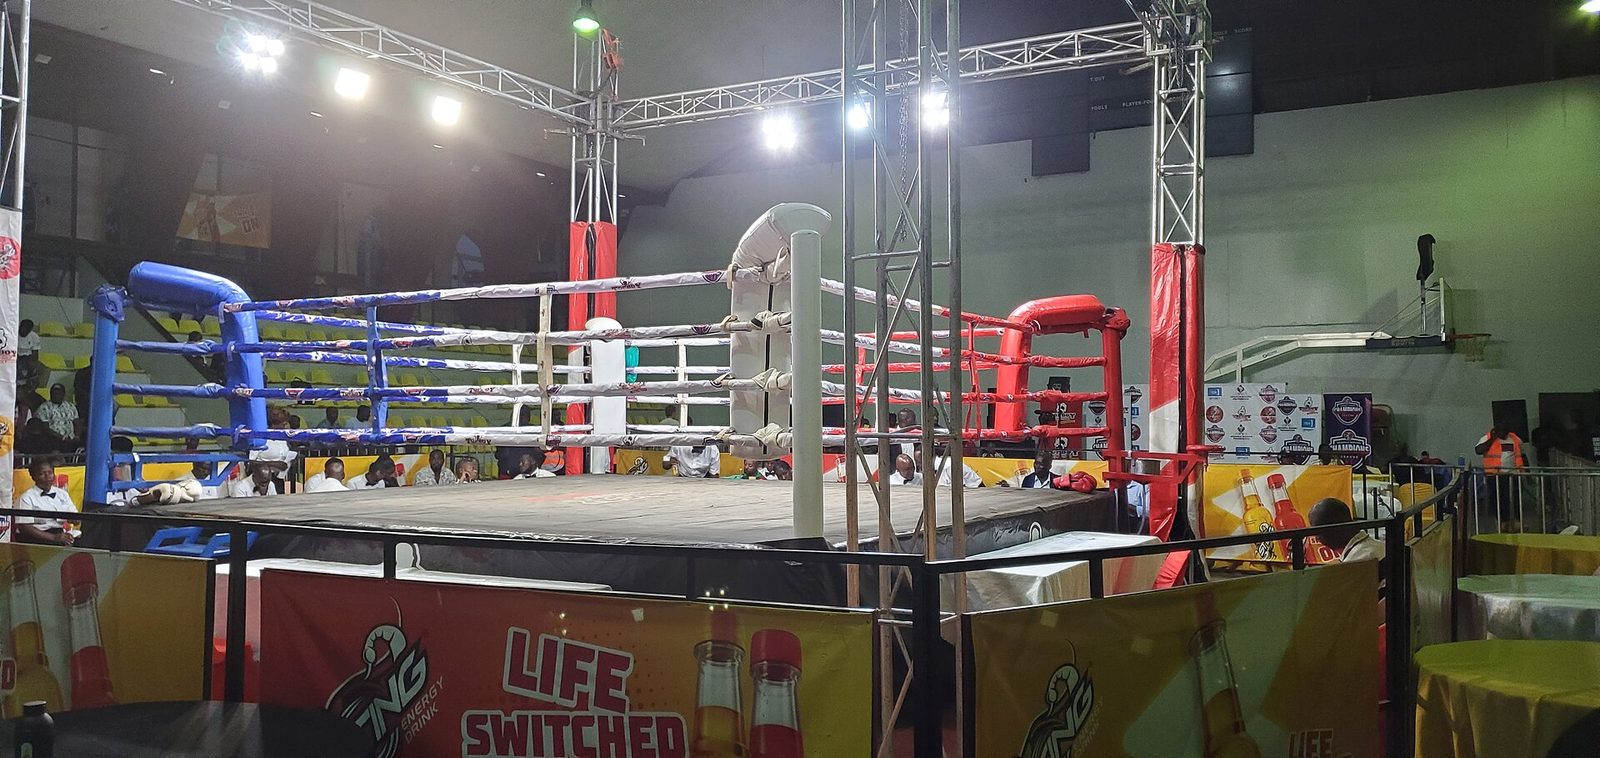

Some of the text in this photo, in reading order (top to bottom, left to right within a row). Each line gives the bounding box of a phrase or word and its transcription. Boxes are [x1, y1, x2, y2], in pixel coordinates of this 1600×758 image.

[505, 627, 634, 713] LIFE
[401, 674, 445, 731] ENERGY
[405, 702, 440, 745] DRINK
[464, 710, 688, 758] SWITCHED
